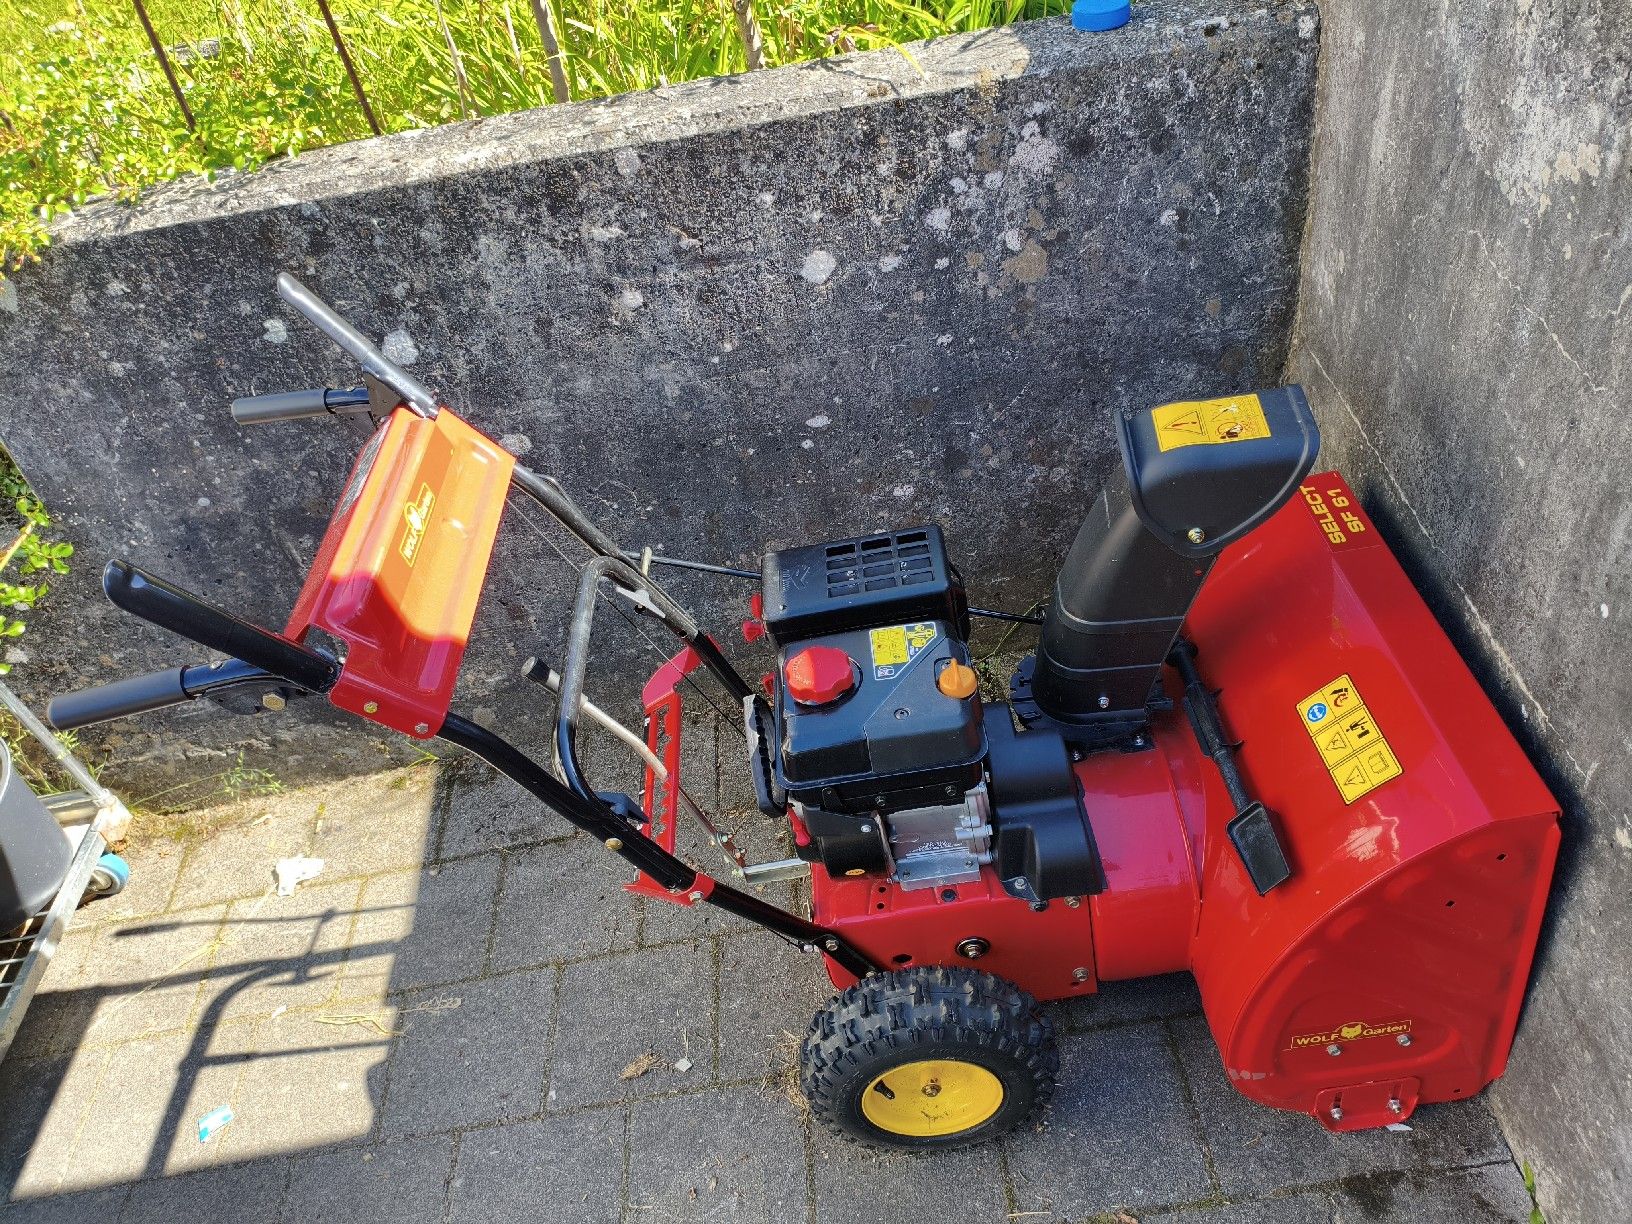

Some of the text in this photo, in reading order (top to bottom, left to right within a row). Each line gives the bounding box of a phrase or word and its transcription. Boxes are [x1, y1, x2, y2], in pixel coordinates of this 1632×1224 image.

[1299, 485, 1347, 544] SELECT
[1326, 488, 1366, 533] SF 61
[1296, 1024, 1407, 1045] WOLF Garten
